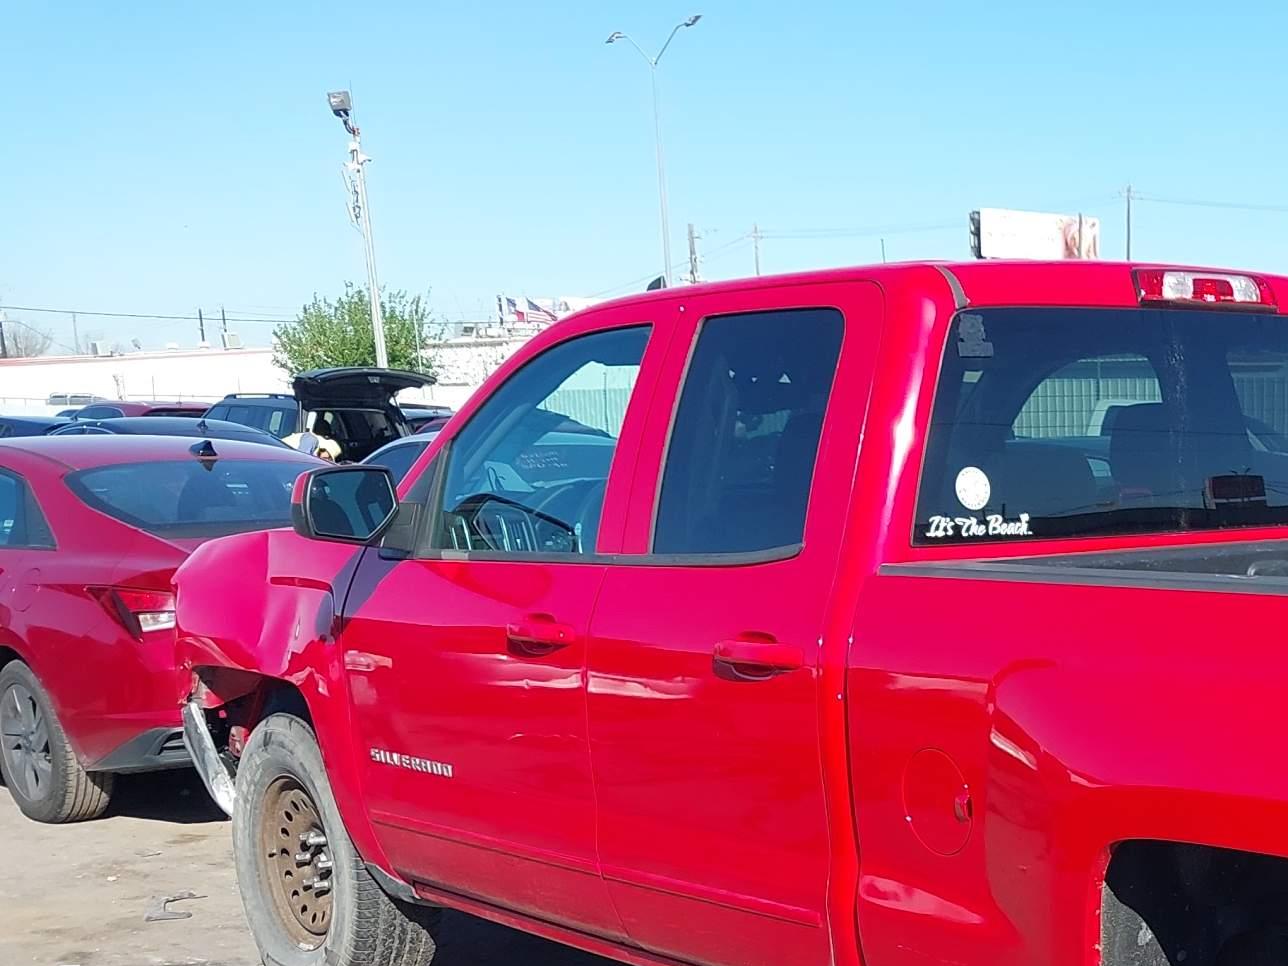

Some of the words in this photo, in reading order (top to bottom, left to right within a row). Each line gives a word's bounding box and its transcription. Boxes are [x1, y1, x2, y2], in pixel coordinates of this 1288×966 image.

[925, 515, 955, 537] It's
[954, 516, 986, 536] The
[370, 748, 453, 777] SILVERADO
